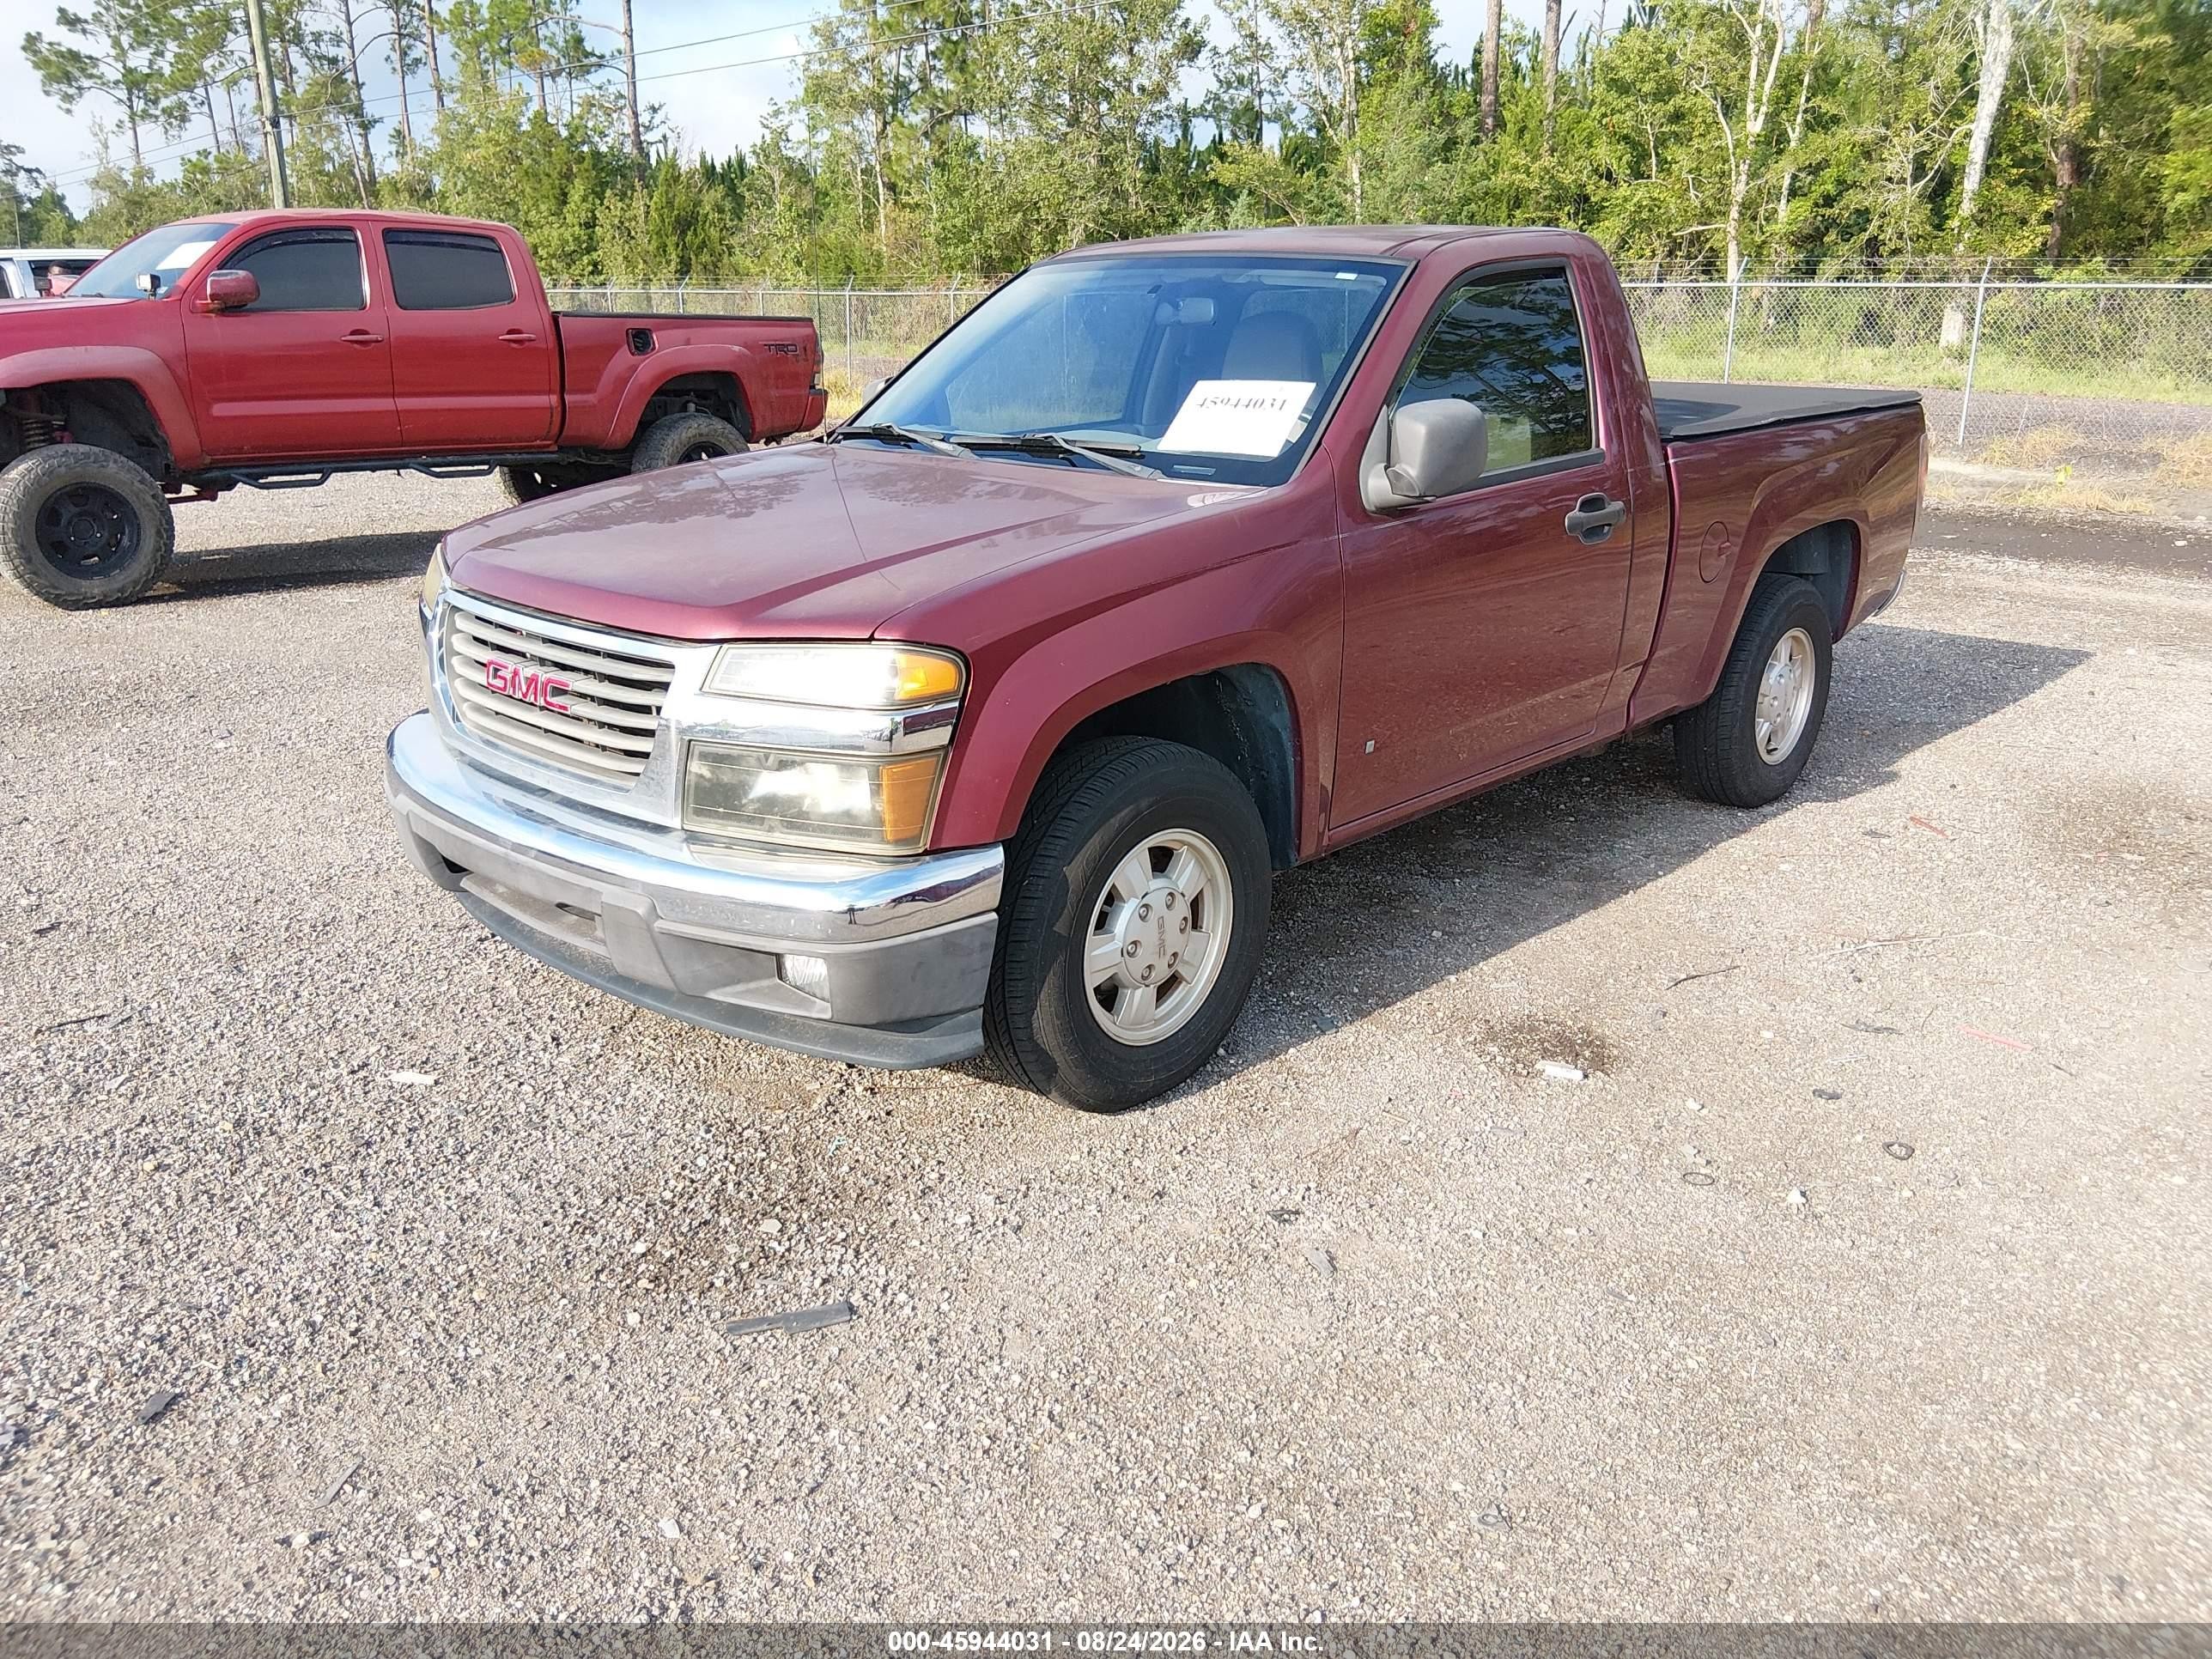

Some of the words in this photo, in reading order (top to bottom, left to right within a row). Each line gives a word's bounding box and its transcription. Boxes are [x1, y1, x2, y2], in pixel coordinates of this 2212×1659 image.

[1196, 397, 1286, 411] 45944031
[485, 658, 573, 714] GMC
[1158, 915, 1166, 959] GMC
